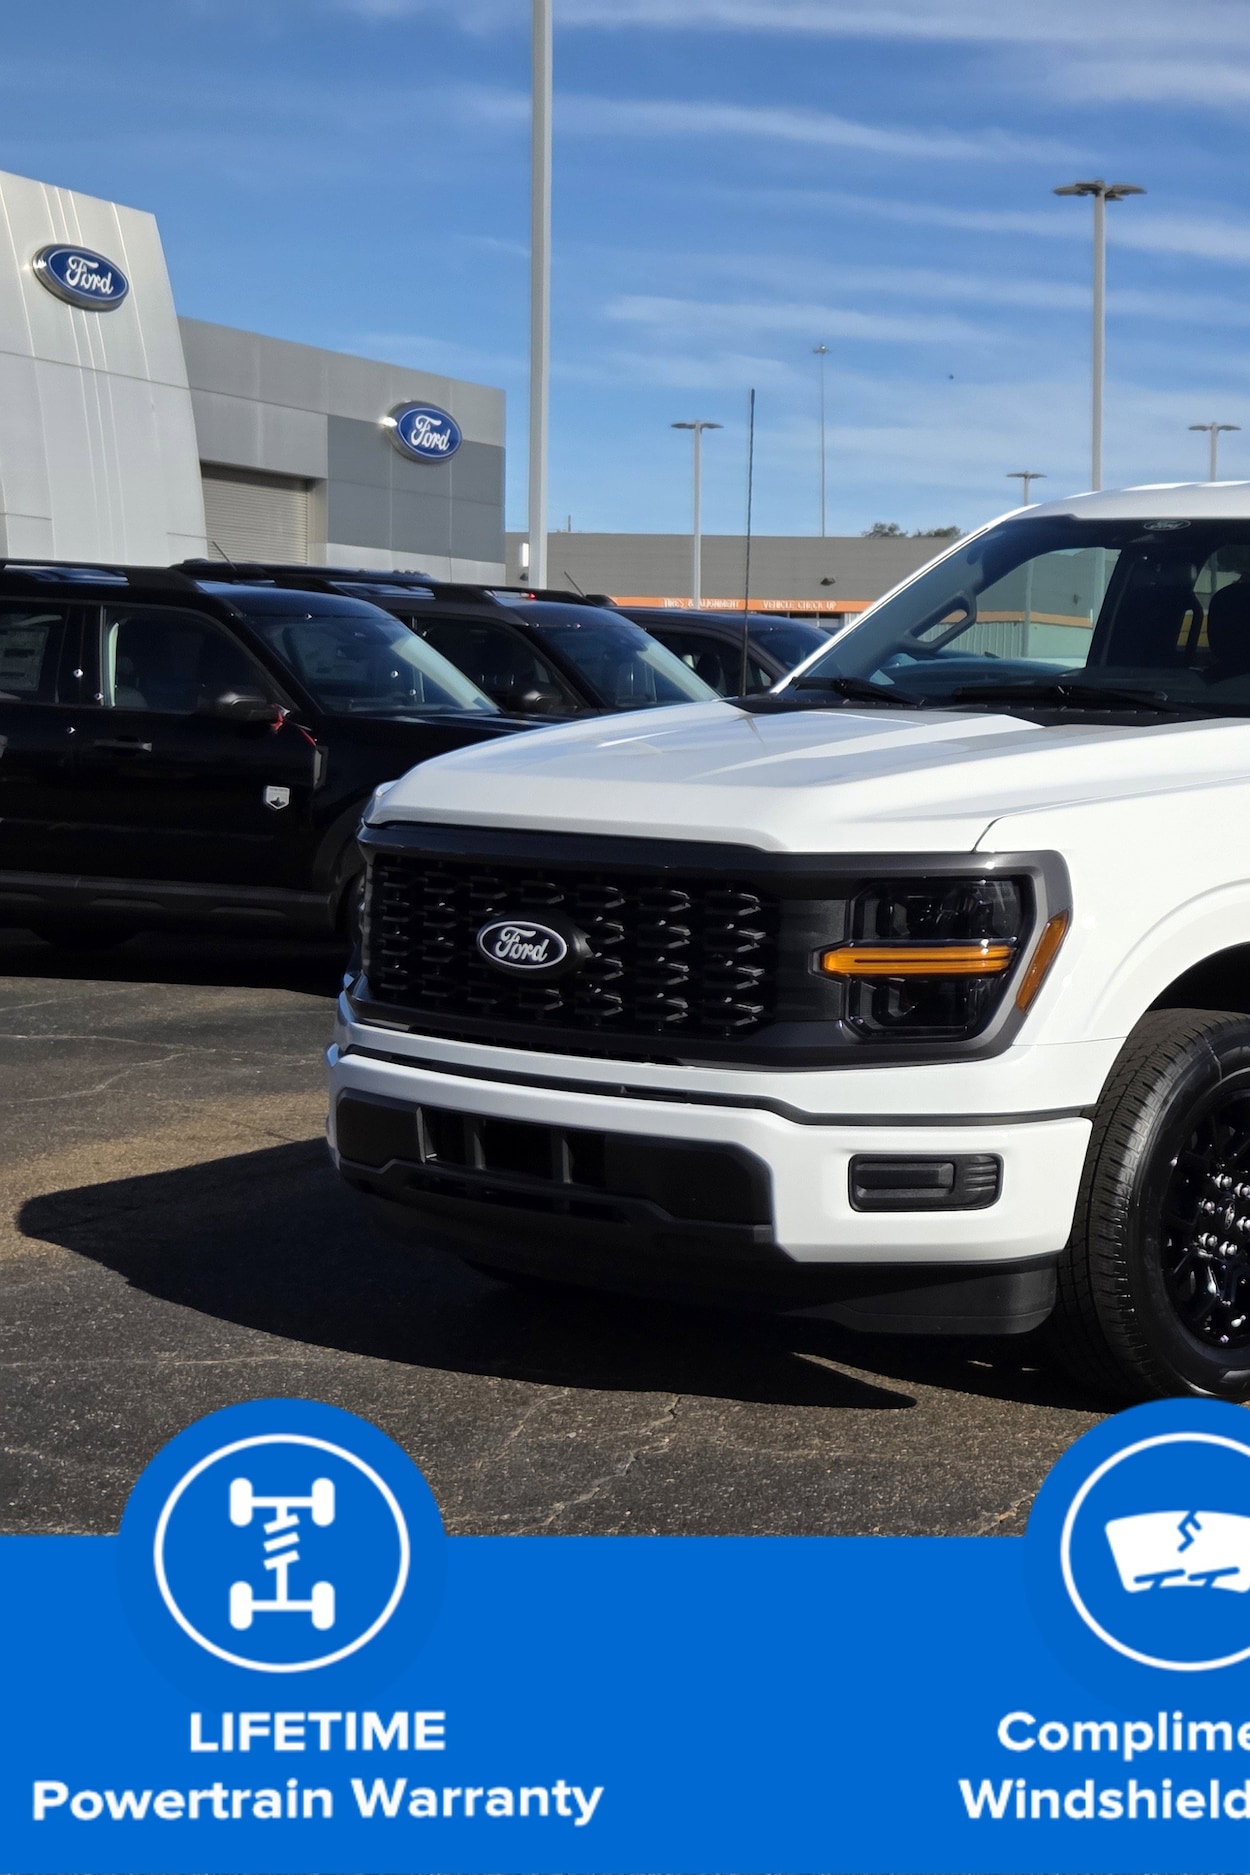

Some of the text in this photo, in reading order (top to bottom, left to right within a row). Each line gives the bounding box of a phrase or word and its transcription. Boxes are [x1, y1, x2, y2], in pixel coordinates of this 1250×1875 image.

[66, 255, 114, 295] Ford
[411, 415, 451, 451] Ford
[762, 600, 837, 610] VEHICLE CHECK UP
[495, 926, 549, 962] Ford
